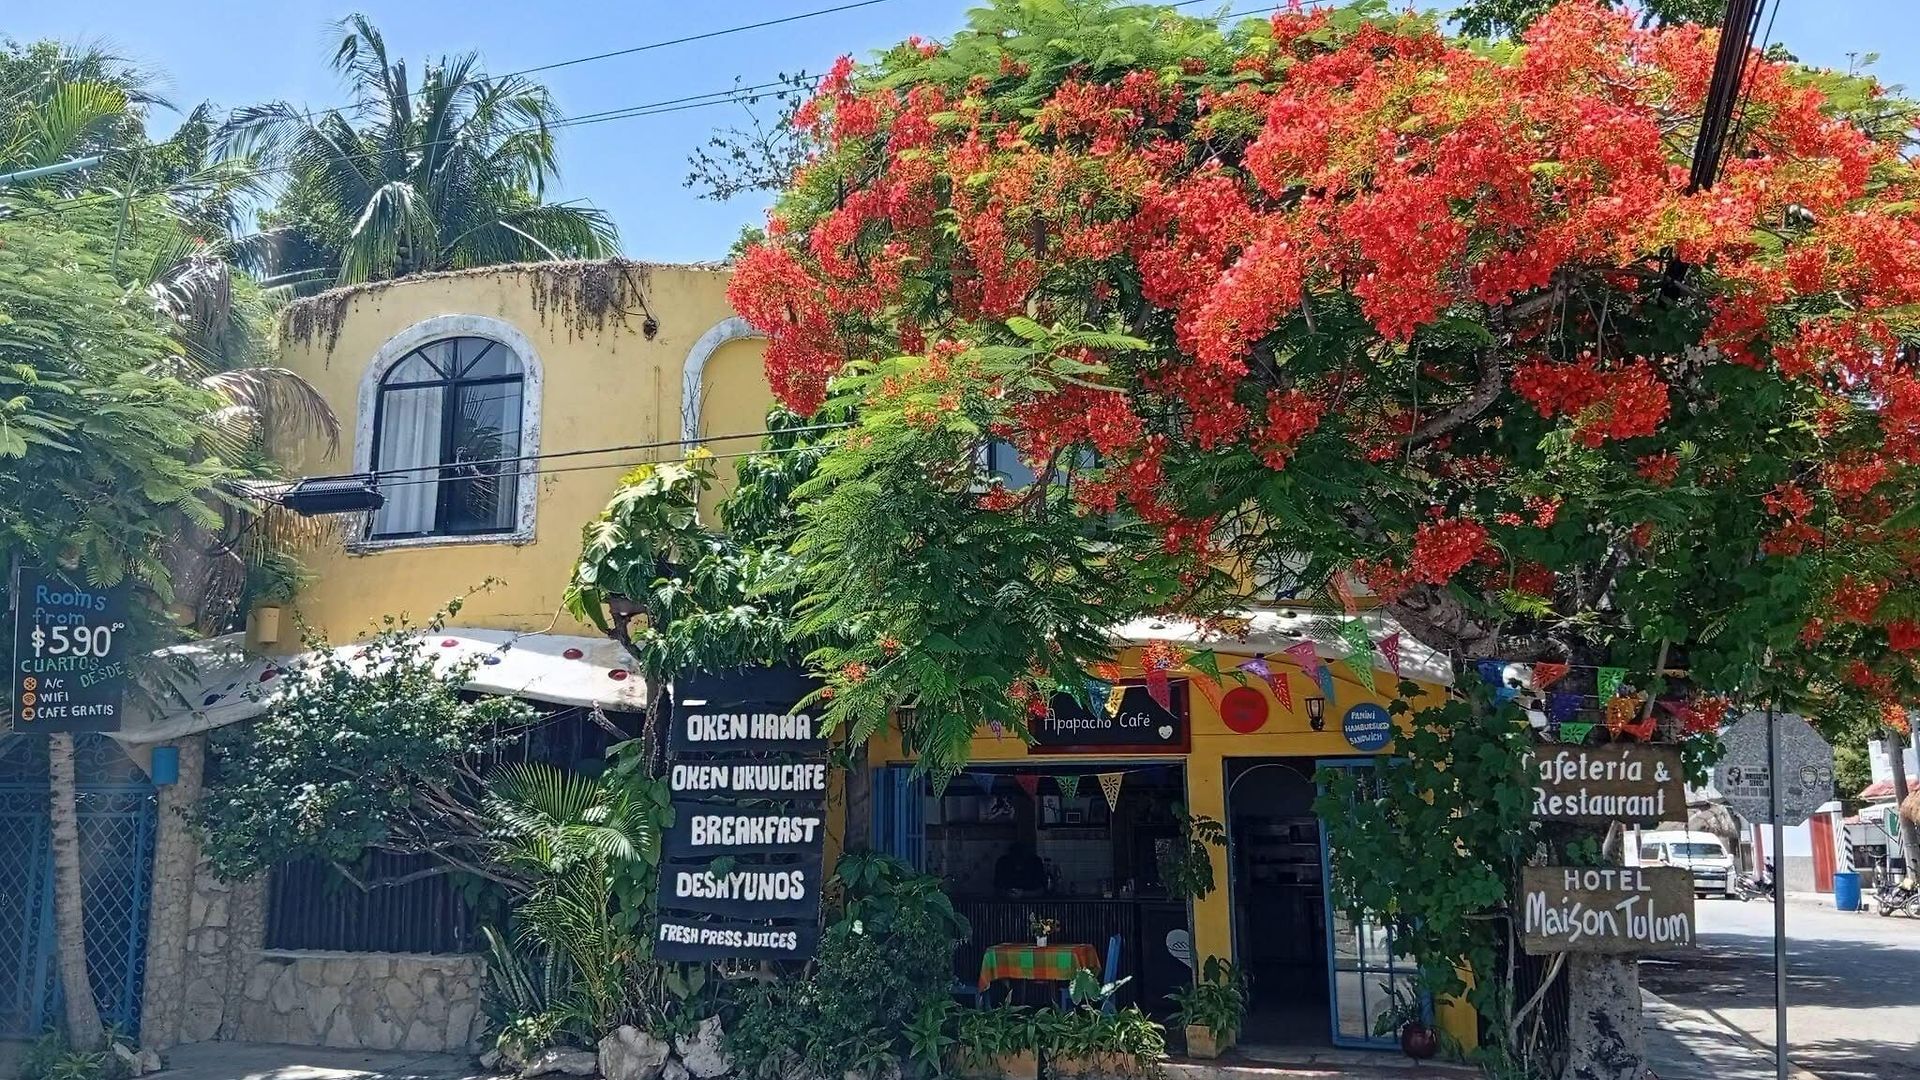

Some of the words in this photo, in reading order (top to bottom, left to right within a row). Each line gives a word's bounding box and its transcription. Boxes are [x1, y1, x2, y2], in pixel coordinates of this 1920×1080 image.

[36, 585, 106, 611] Rooms
[33, 607, 86, 625] from
[21, 656, 99, 672] CUARTOS
[80, 661, 125, 688] DESDE
[44, 678, 64, 689] A/C
[40, 692, 69, 702] WIFI
[38, 707, 67, 718] CAFE
[71, 705, 114, 716] GRATIS
[1044, 708, 1112, 735] Apapacho
[1119, 712, 1150, 728] Café
[687, 714, 748, 741] OKEN
[672, 764, 729, 791] OKEN
[1654, 761, 1671, 782] &
[1532, 787, 1665, 815] Restaurant
[691, 816, 820, 845] BREAKFAST
[676, 871, 805, 900] DESAYUNOS
[1564, 870, 1650, 891] HOTEL
[1526, 890, 1618, 943] Maison
[660, 924, 699, 943] FRESH
[701, 929, 743, 947] PRESS
[744, 932, 797, 950] JUICES
